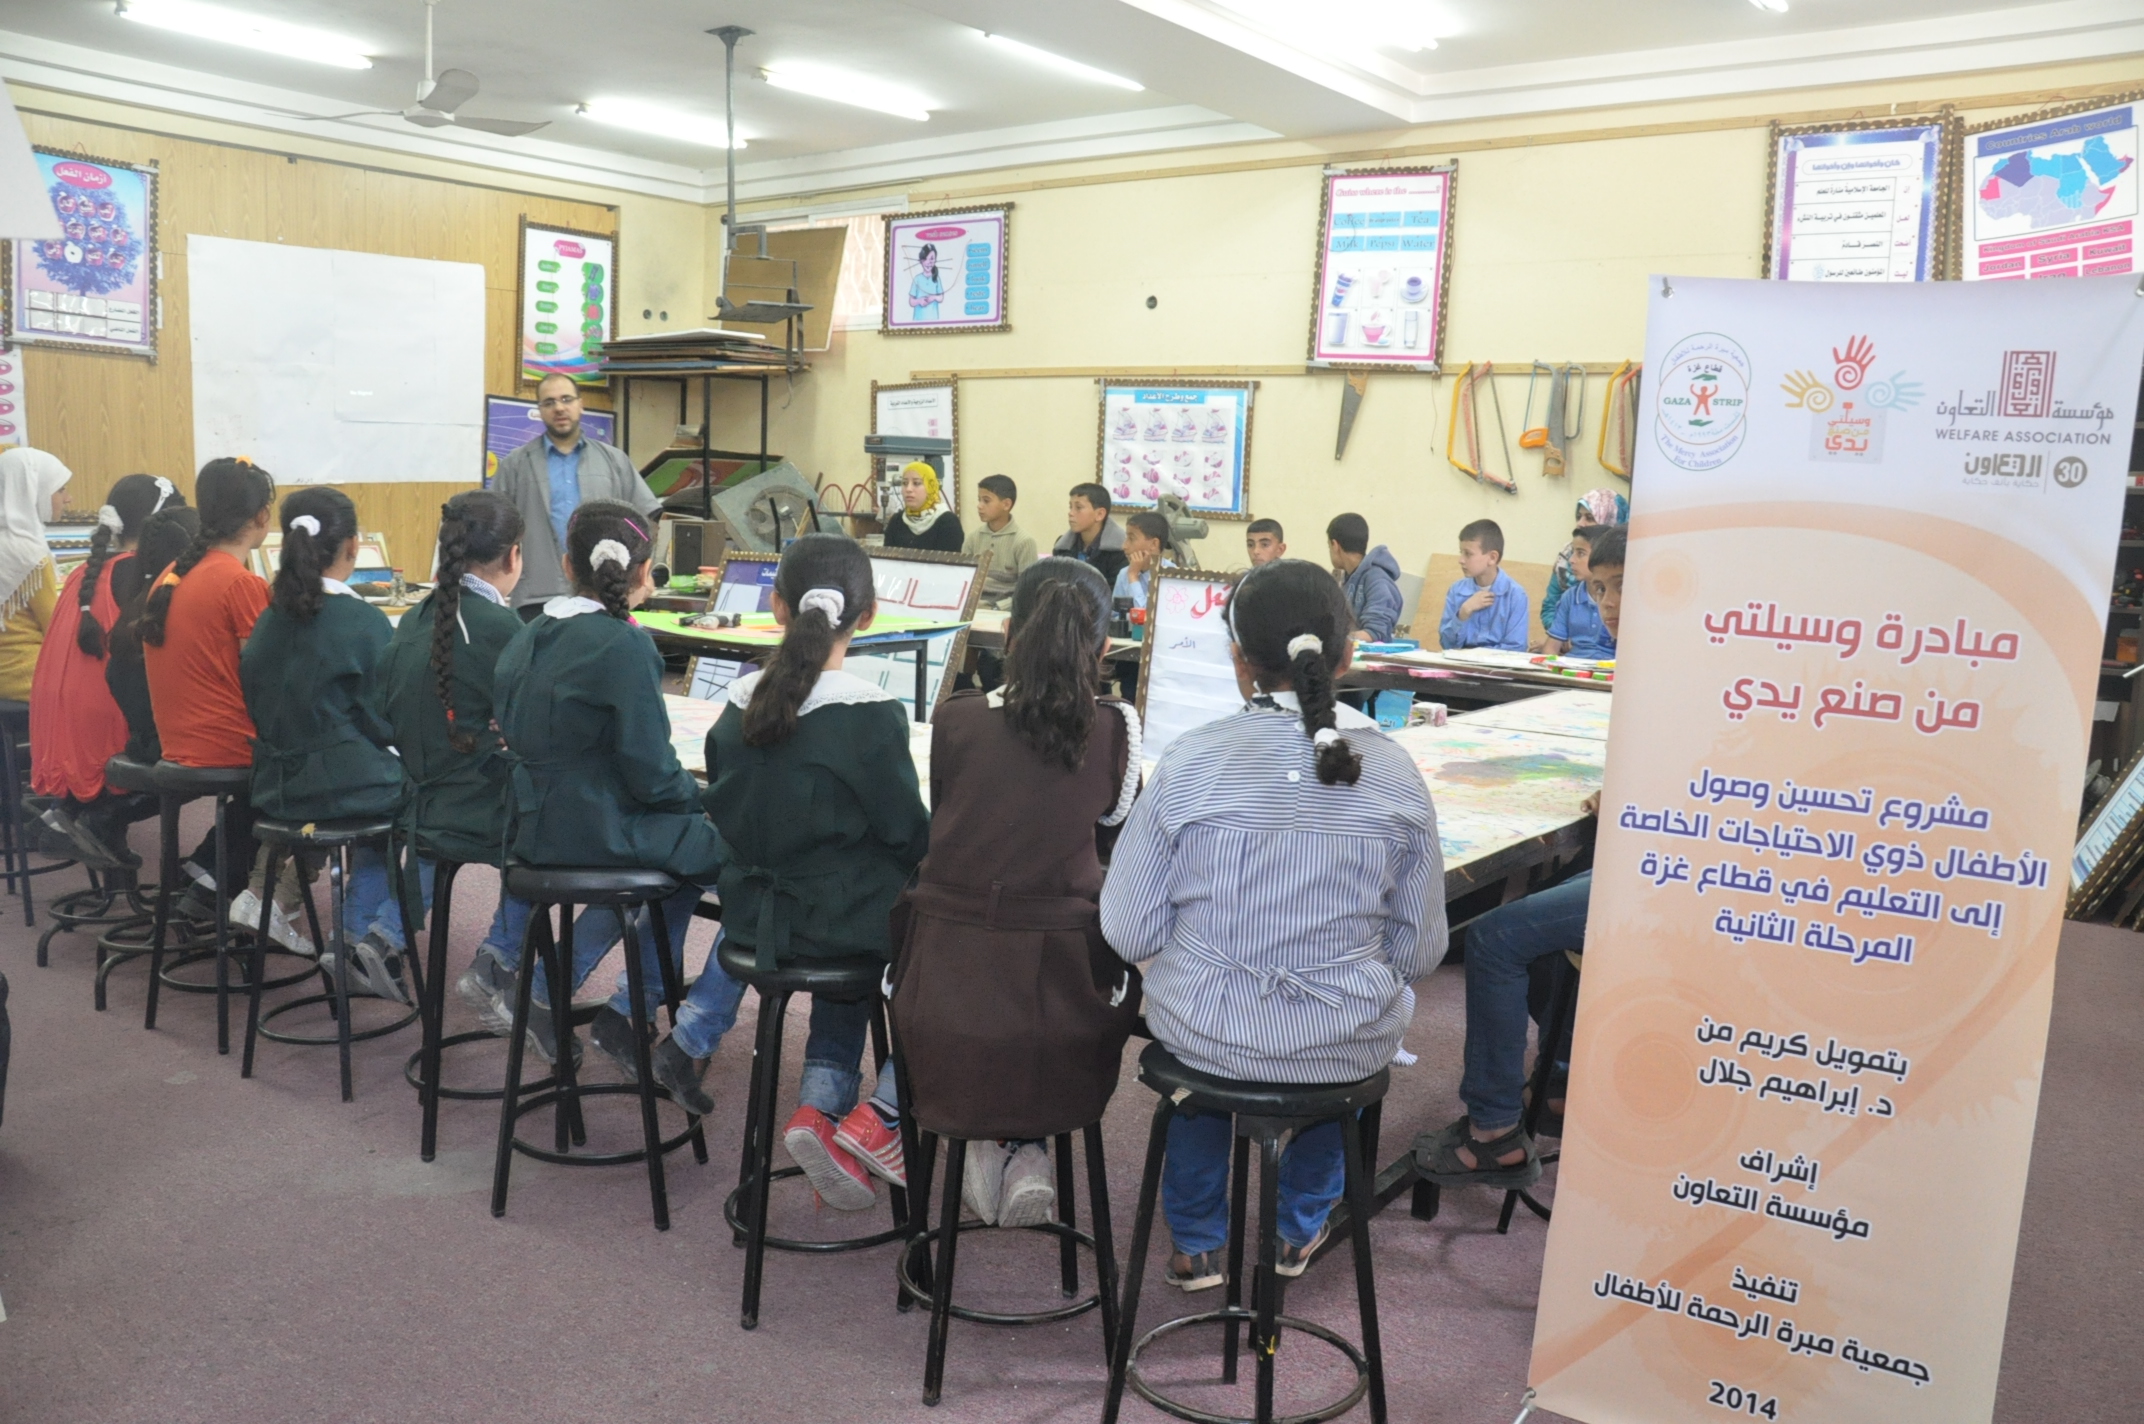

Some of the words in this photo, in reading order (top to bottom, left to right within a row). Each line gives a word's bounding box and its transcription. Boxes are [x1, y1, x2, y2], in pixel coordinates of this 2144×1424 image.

[1985, 132, 2048, 151] Countries
[2049, 124, 2081, 140] Arab
[2084, 115, 2124, 131] world
[56, 166, 82, 178] الفعل
[1334, 215, 1365, 226] Coffee
[1412, 215, 1429, 224] Tea
[1370, 240, 1394, 250] Pepsi
[1403, 239, 1436, 248] Water
[1983, 241, 2025, 253] Kingdom
[2027, 238, 2037, 247] of
[2039, 235, 2067, 246] Saudi
[2069, 229, 2100, 240] Arabia
[2103, 224, 2125, 233] KSA
[2089, 243, 2126, 256] Kuwait
[1983, 260, 2023, 273] Jordan
[2037, 251, 2071, 264] Syria
[2085, 261, 2131, 276] Lebanon
[1687, 363, 1702, 373] غزة
[1704, 365, 1723, 374] قطاع
[1663, 397, 1692, 406] GAZA
[1712, 398, 1744, 407] STRIP
[1828, 408, 1871, 427] وسيلتي
[1936, 389, 1997, 427] التعاون
[2052, 400, 2115, 431] مؤسسة
[1660, 434, 1673, 449] The
[1674, 444, 1696, 459] Mercy
[1699, 434, 1739, 458] Association
[1825, 435, 1868, 456] يدي
[1827, 425, 1851, 437] صنع
[1851, 428, 1870, 437] من
[1935, 428, 1999, 442] WELFARE
[2004, 431, 2112, 445] ASSOCIATION
[1673, 455, 1687, 466] For
[1688, 457, 1722, 468] Children
[2057, 461, 2084, 483] 30
[1704, 602, 1862, 659] وسيلتي
[1876, 614, 2019, 667] مبادرة
[1723, 677, 1801, 720] يدي
[1814, 681, 1902, 728] صنع
[1915, 690, 1980, 733] من
[1690, 769, 1770, 808] وصول
[1778, 781, 1873, 813] تحسين
[1619, 804, 1709, 839] الخاصة
[1879, 794, 1989, 830] مشروع
[1718, 819, 1854, 859] الاحتياجات
[1640, 852, 1689, 885] غزة
[1863, 842, 1925, 873] ذوي
[1934, 847, 2048, 887] الأطفال
[1697, 862, 1772, 894] قطاع
[1780, 876, 1830, 904] في
[1837, 886, 1941, 920] التعليم
[1715, 908, 1795, 944] الثانية
[1950, 902, 2004, 937] إلى
[1804, 922, 1913, 963] المرحلة
[1697, 1017, 1733, 1043] من
[1740, 1027, 1808, 1059] كريم
[1700, 1058, 1752, 1092] جلال
[1816, 1040, 1907, 1082] بتمويل
[1760, 1076, 1858, 1115] إبراهيم
[1867, 1097, 1892, 1116] د.
[1740, 1150, 1818, 1190] إشراف
[1673, 1175, 1758, 1211] التعاون
[1766, 1194, 1870, 1239] مؤسسة
[1594, 1273, 1681, 1312] للأطفال
[1732, 1268, 1798, 1303] تنفيذ
[1687, 1297, 1769, 1338] الرحمة
[1777, 1321, 1834, 1355] مبرة
[1842, 1339, 1930, 1386] جمعية
[1708, 1381, 1777, 1420] 2014
